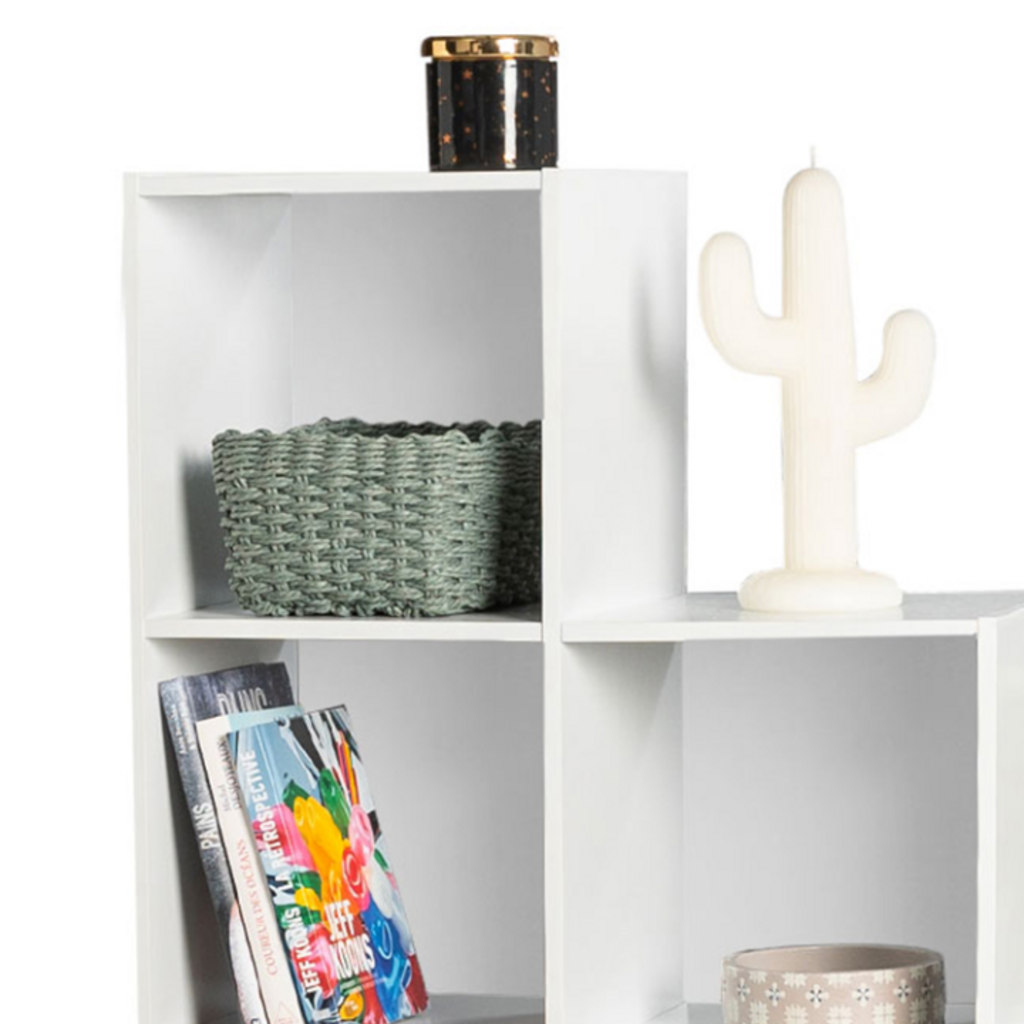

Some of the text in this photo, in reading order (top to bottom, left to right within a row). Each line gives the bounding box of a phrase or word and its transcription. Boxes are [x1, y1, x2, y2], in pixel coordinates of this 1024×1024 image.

[192, 802, 220, 850] PAINS
[241, 749, 322, 993] JEFF KOONS LA RÉTROSPECTIVE
[324, 899, 354, 941] JEFF
[255, 915, 278, 976] COUREUR
[330, 933, 375, 980] KOONS
